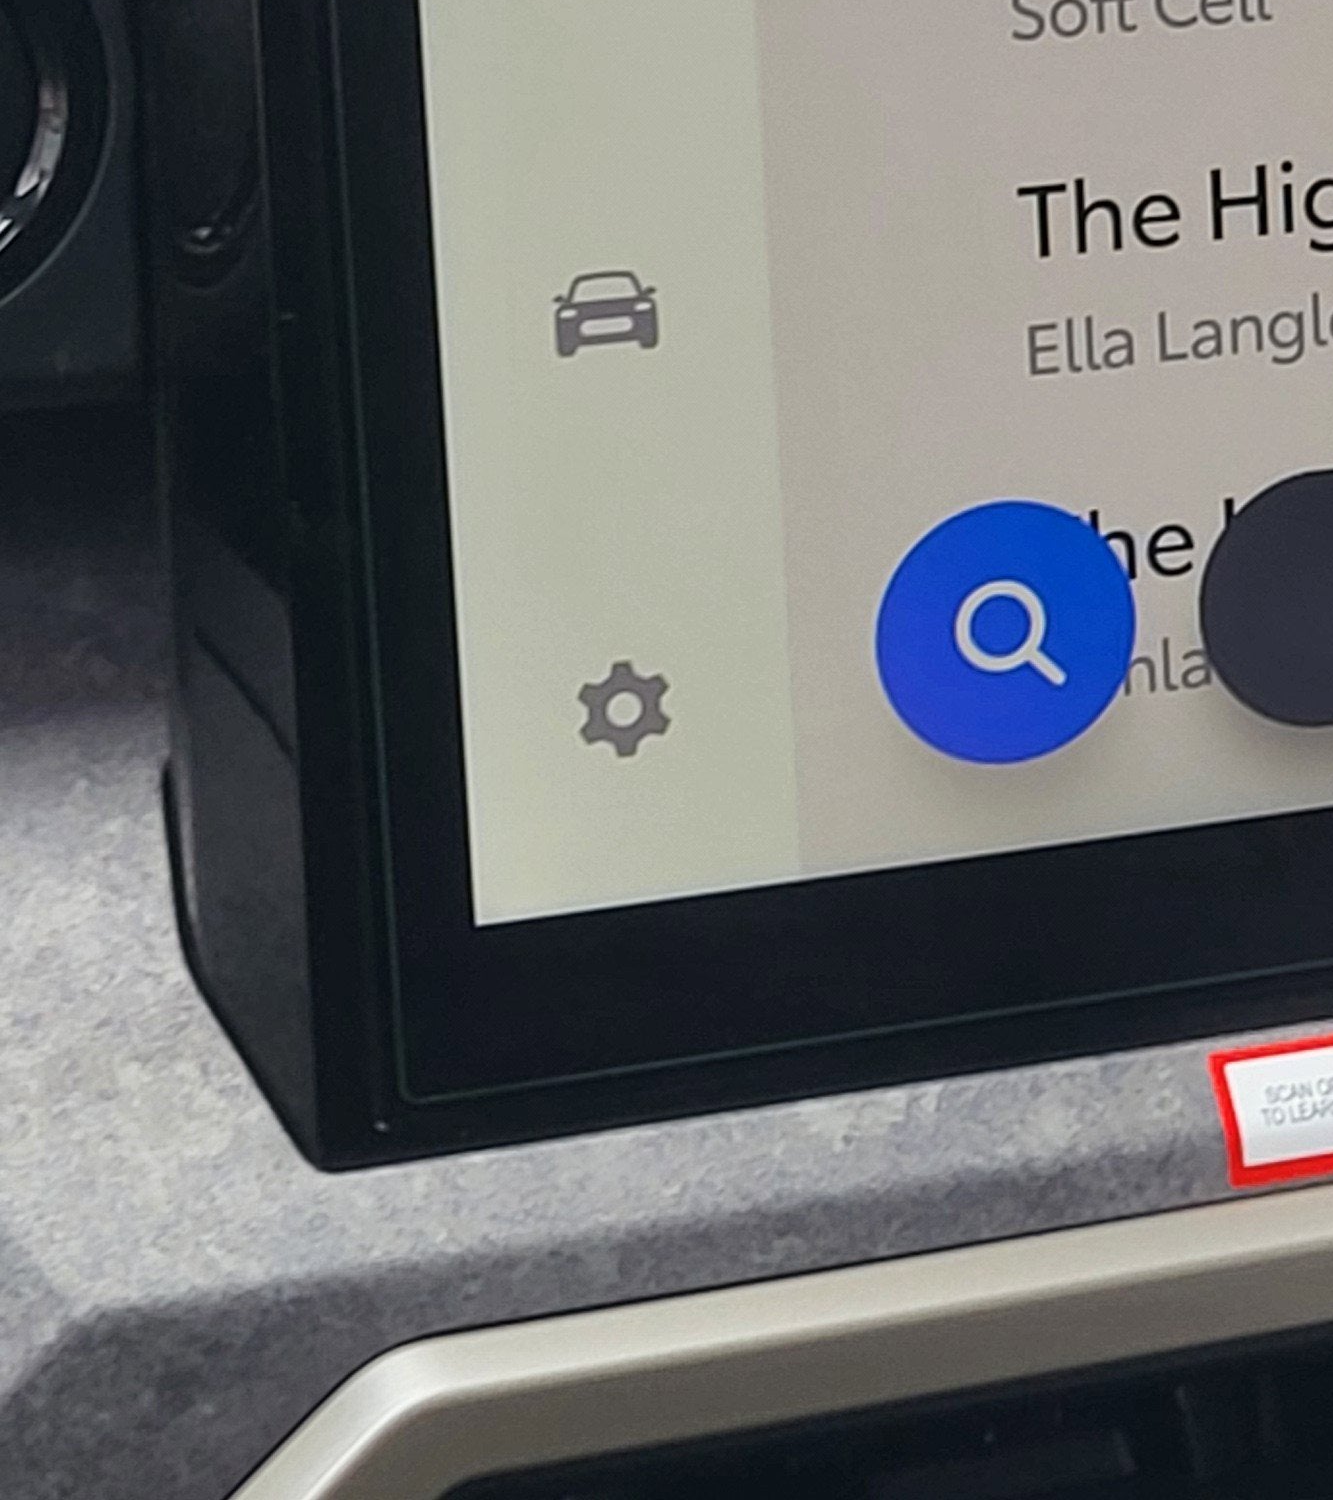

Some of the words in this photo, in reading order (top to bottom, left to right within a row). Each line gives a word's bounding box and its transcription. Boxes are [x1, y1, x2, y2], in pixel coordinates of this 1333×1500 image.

[1017, 177, 1180, 258] The
[1026, 311, 1136, 377] Ella
[1077, 509, 1194, 581] he
[1124, 638, 1212, 696] nla
[1261, 1106, 1285, 1125] TO
[1265, 1080, 1313, 1103] SCAN
